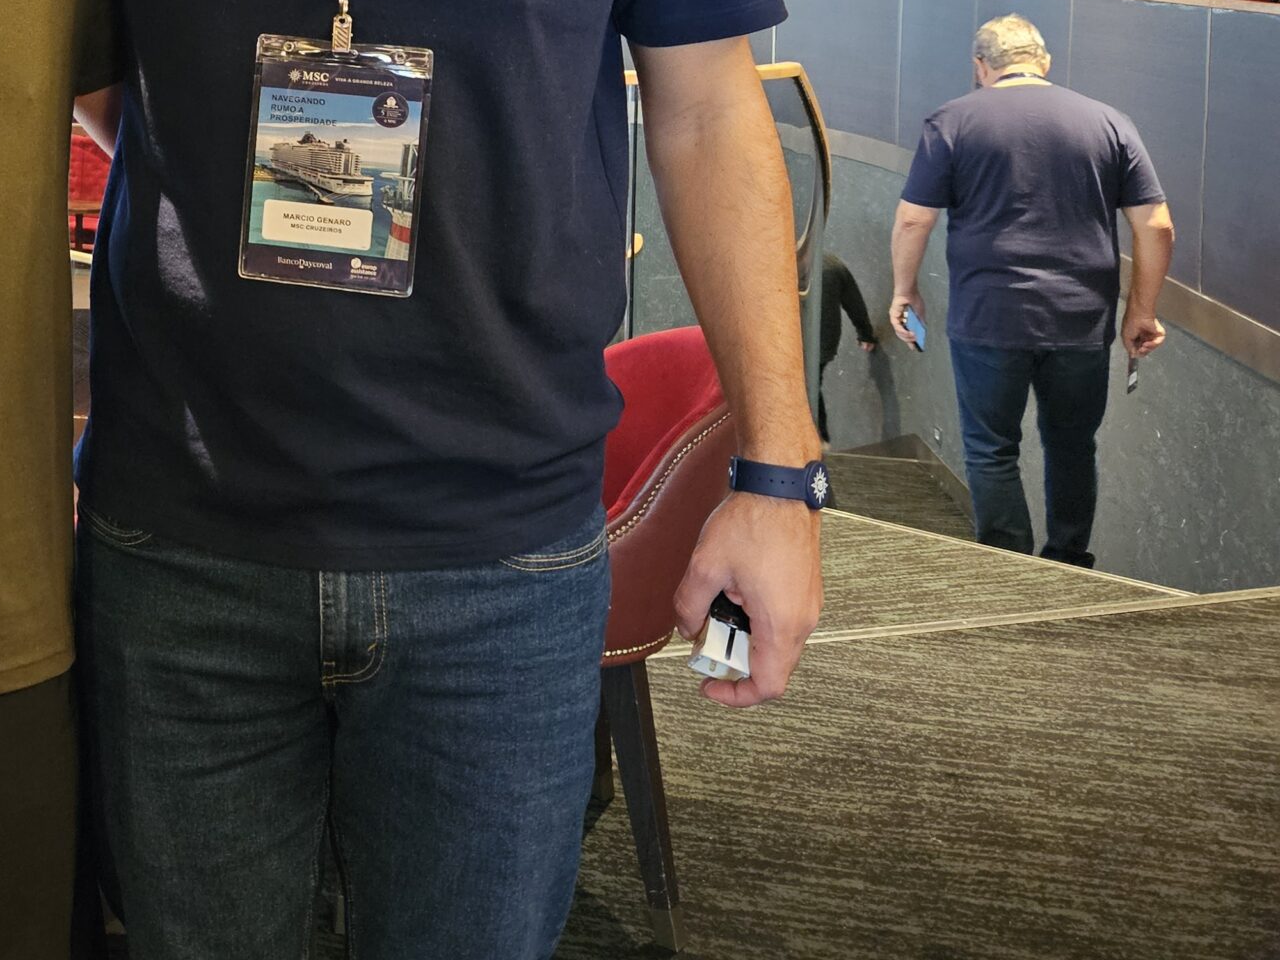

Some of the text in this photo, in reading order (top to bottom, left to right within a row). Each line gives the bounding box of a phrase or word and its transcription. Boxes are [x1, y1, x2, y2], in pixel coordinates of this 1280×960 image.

[302, 70, 330, 82] MSC
[271, 94, 326, 106] NAVEGANDO
[270, 103, 297, 113] RUMO
[270, 113, 337, 127] PROSPERIDADE
[283, 212, 352, 227] MARCIO GENARO
[305, 224, 343, 234] CRUZEIROS
